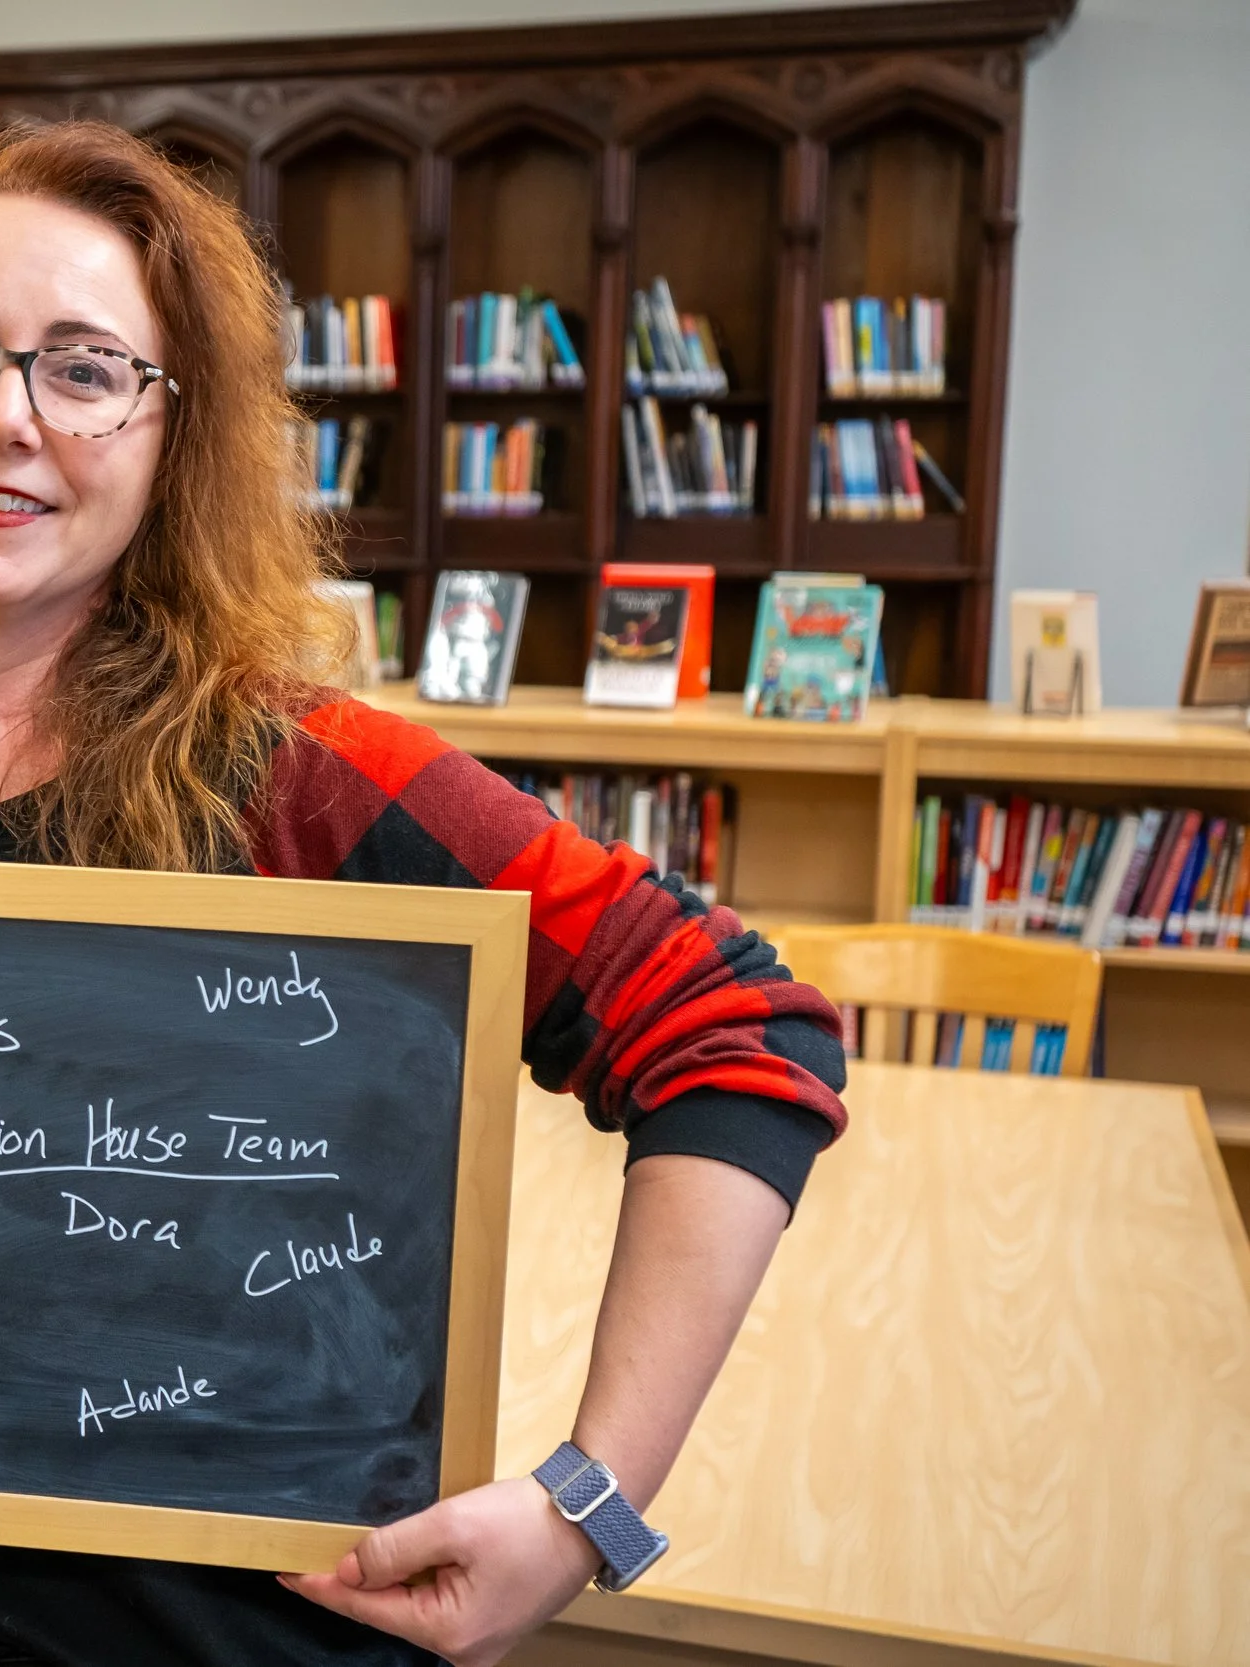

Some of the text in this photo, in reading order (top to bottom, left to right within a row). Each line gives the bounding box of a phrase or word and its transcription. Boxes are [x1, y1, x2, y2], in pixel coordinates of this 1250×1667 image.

[197, 952, 338, 1046] Wendy
[86, 1098, 187, 1163] House
[209, 1115, 327, 1162] Team
[61, 1192, 180, 1249] Dora
[245, 1213, 382, 1296] Claude
[78, 1366, 217, 1436] Adande
